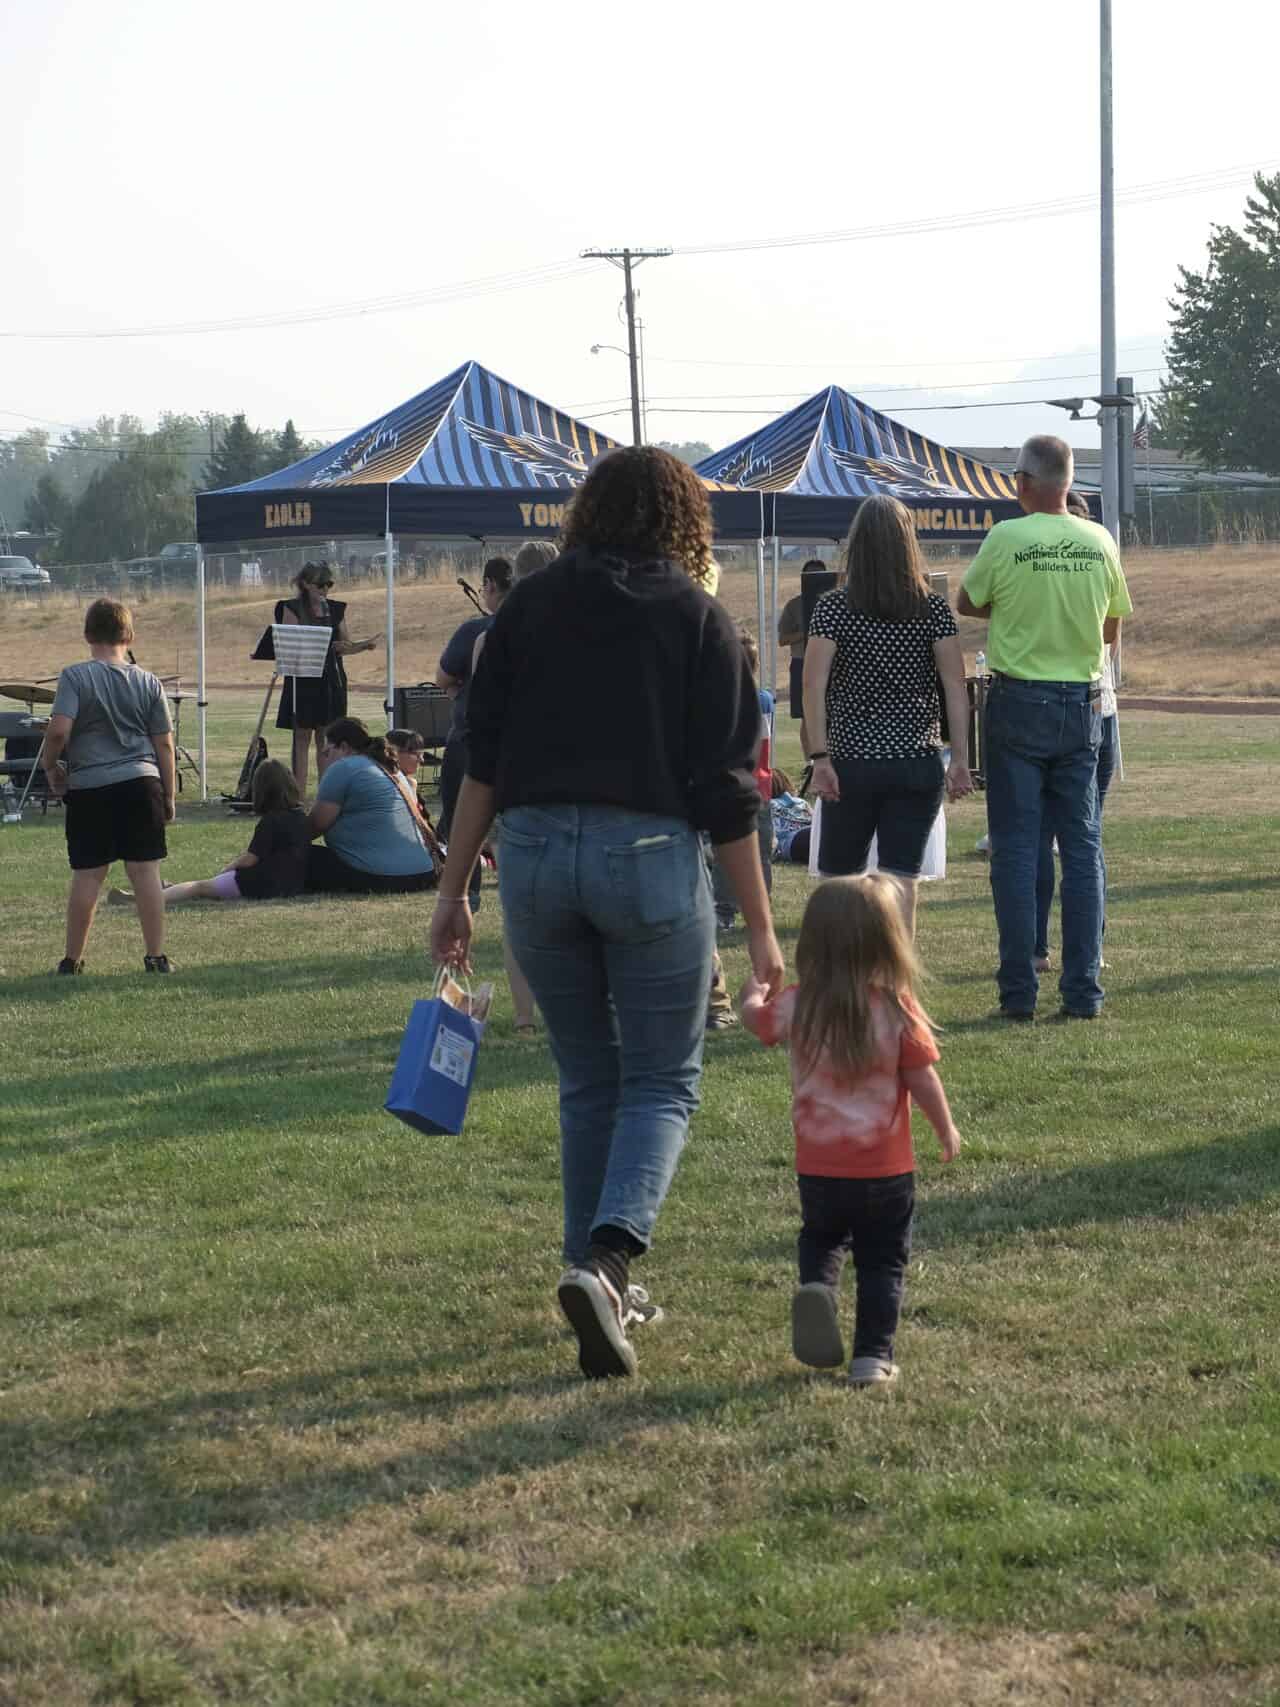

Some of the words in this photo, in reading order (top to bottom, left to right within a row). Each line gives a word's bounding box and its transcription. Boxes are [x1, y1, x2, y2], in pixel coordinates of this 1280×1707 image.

[264, 501, 311, 528] EAGLES
[519, 504, 565, 528] YON
[1014, 549, 1058, 564] Northwest
[1061, 551, 1105, 564] Community
[1032, 561, 1071, 572] Builders,
[1073, 562, 1093, 572] LLC
